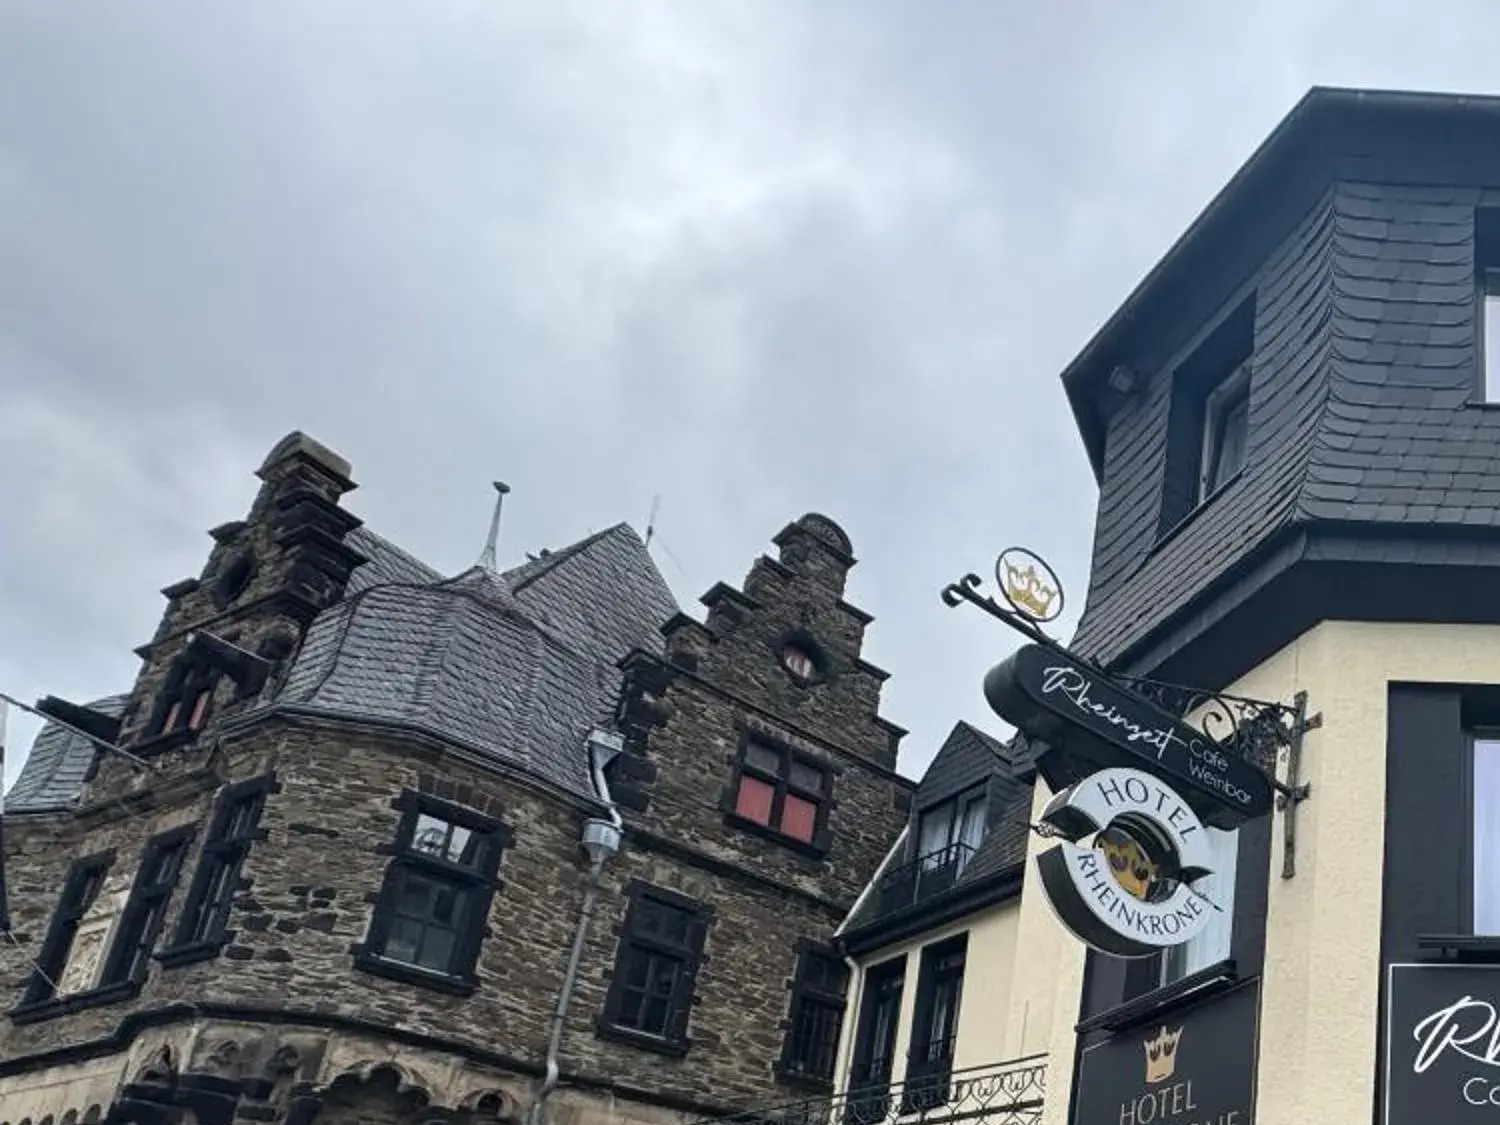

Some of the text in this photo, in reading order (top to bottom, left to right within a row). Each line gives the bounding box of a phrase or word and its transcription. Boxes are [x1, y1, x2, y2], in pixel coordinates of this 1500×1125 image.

[1099, 777, 1202, 844] HOTEL
[1188, 757, 1252, 803] Weinbar
[1077, 852, 1202, 936] RHEINKRONE
